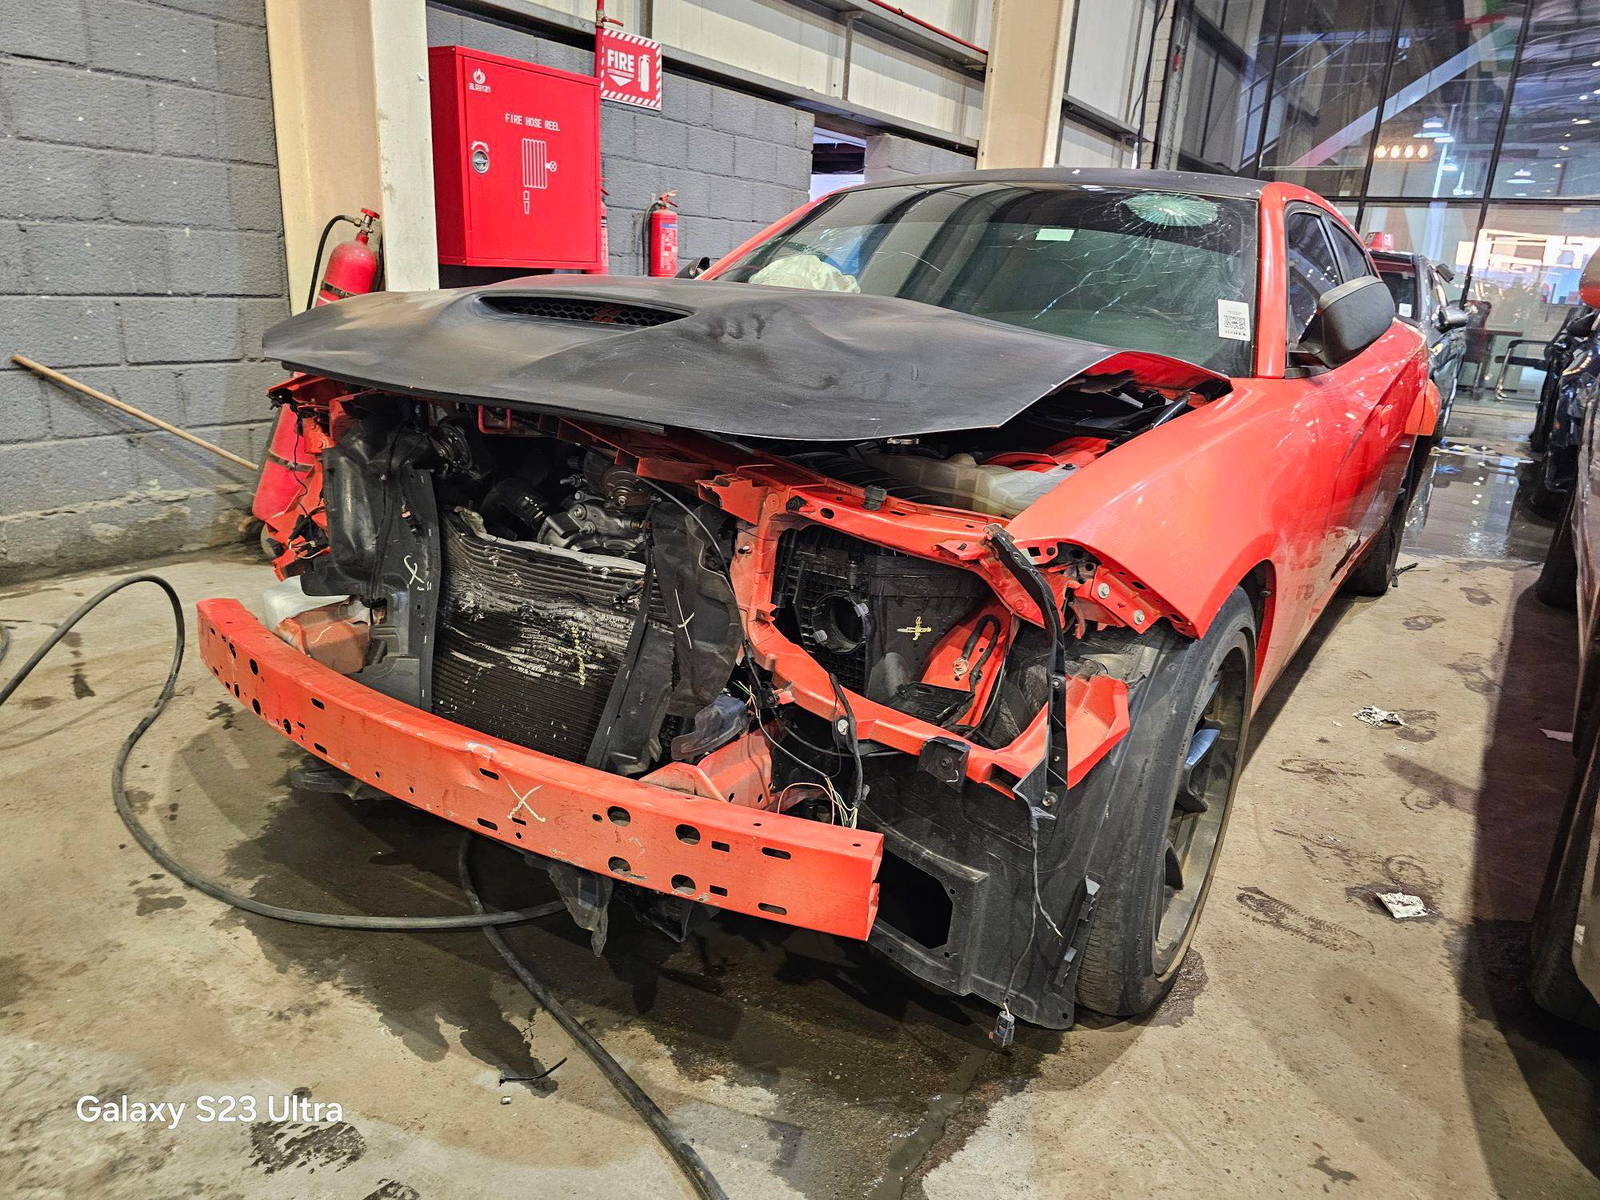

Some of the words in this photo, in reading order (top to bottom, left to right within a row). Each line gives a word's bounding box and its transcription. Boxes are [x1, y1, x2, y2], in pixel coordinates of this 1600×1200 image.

[607, 48, 635, 73] FIRE
[504, 112, 523, 126] FIRE
[525, 116, 543, 129] HOSE
[544, 119, 561, 132] REEL
